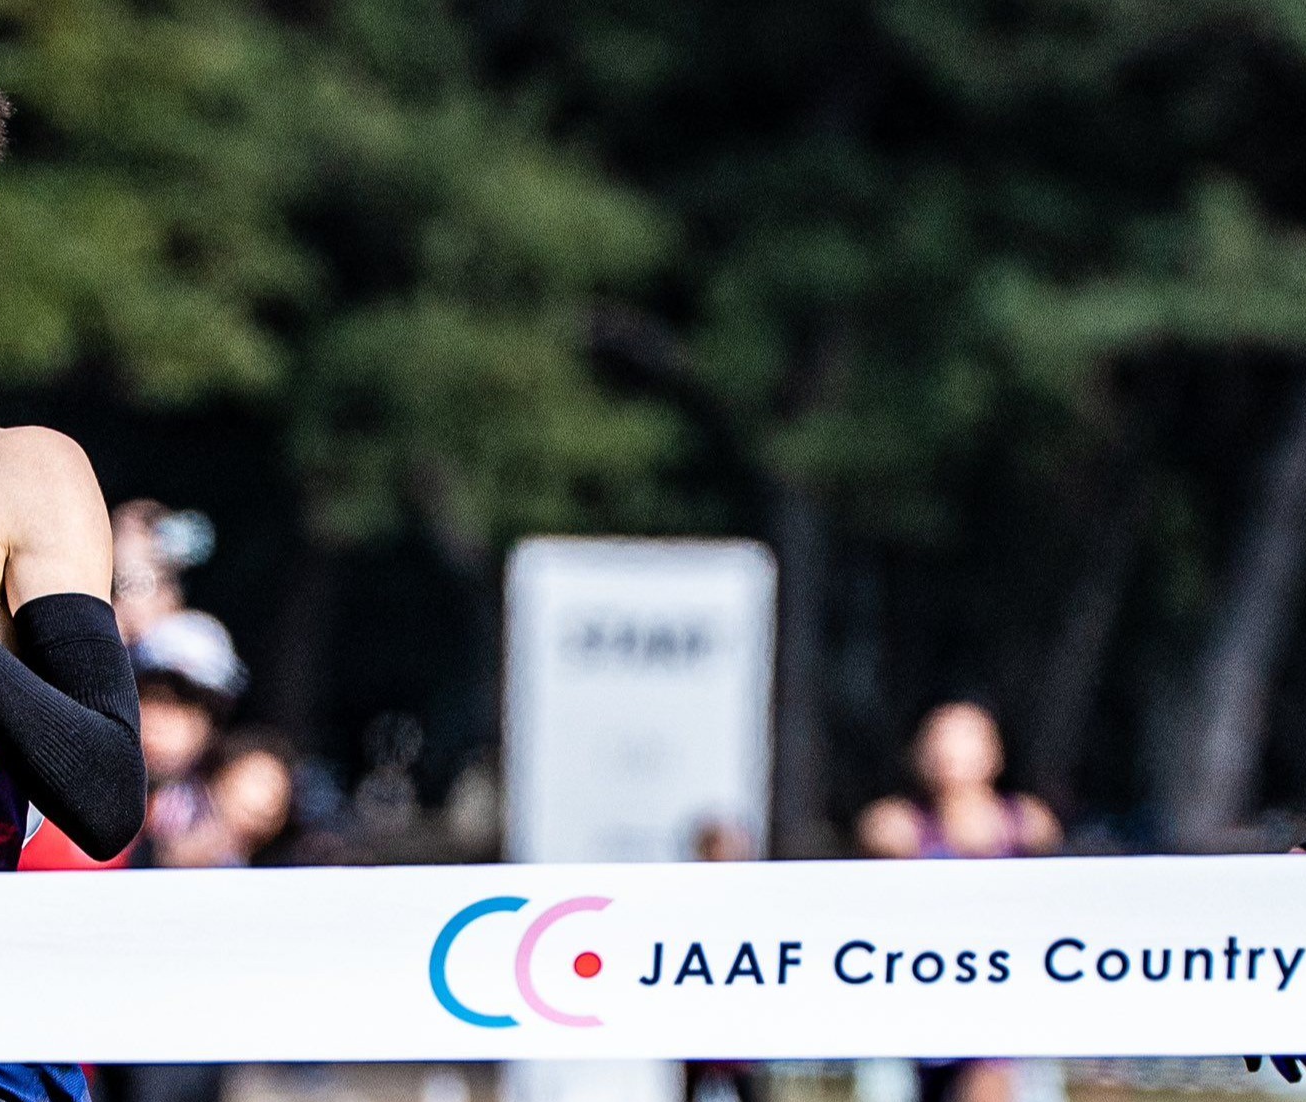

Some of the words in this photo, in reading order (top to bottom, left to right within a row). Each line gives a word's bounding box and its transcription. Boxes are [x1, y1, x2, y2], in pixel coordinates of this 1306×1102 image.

[639, 941, 803, 986] JAAF
[834, 940, 1011, 985] Cross
[1043, 936, 1306, 991] Country
